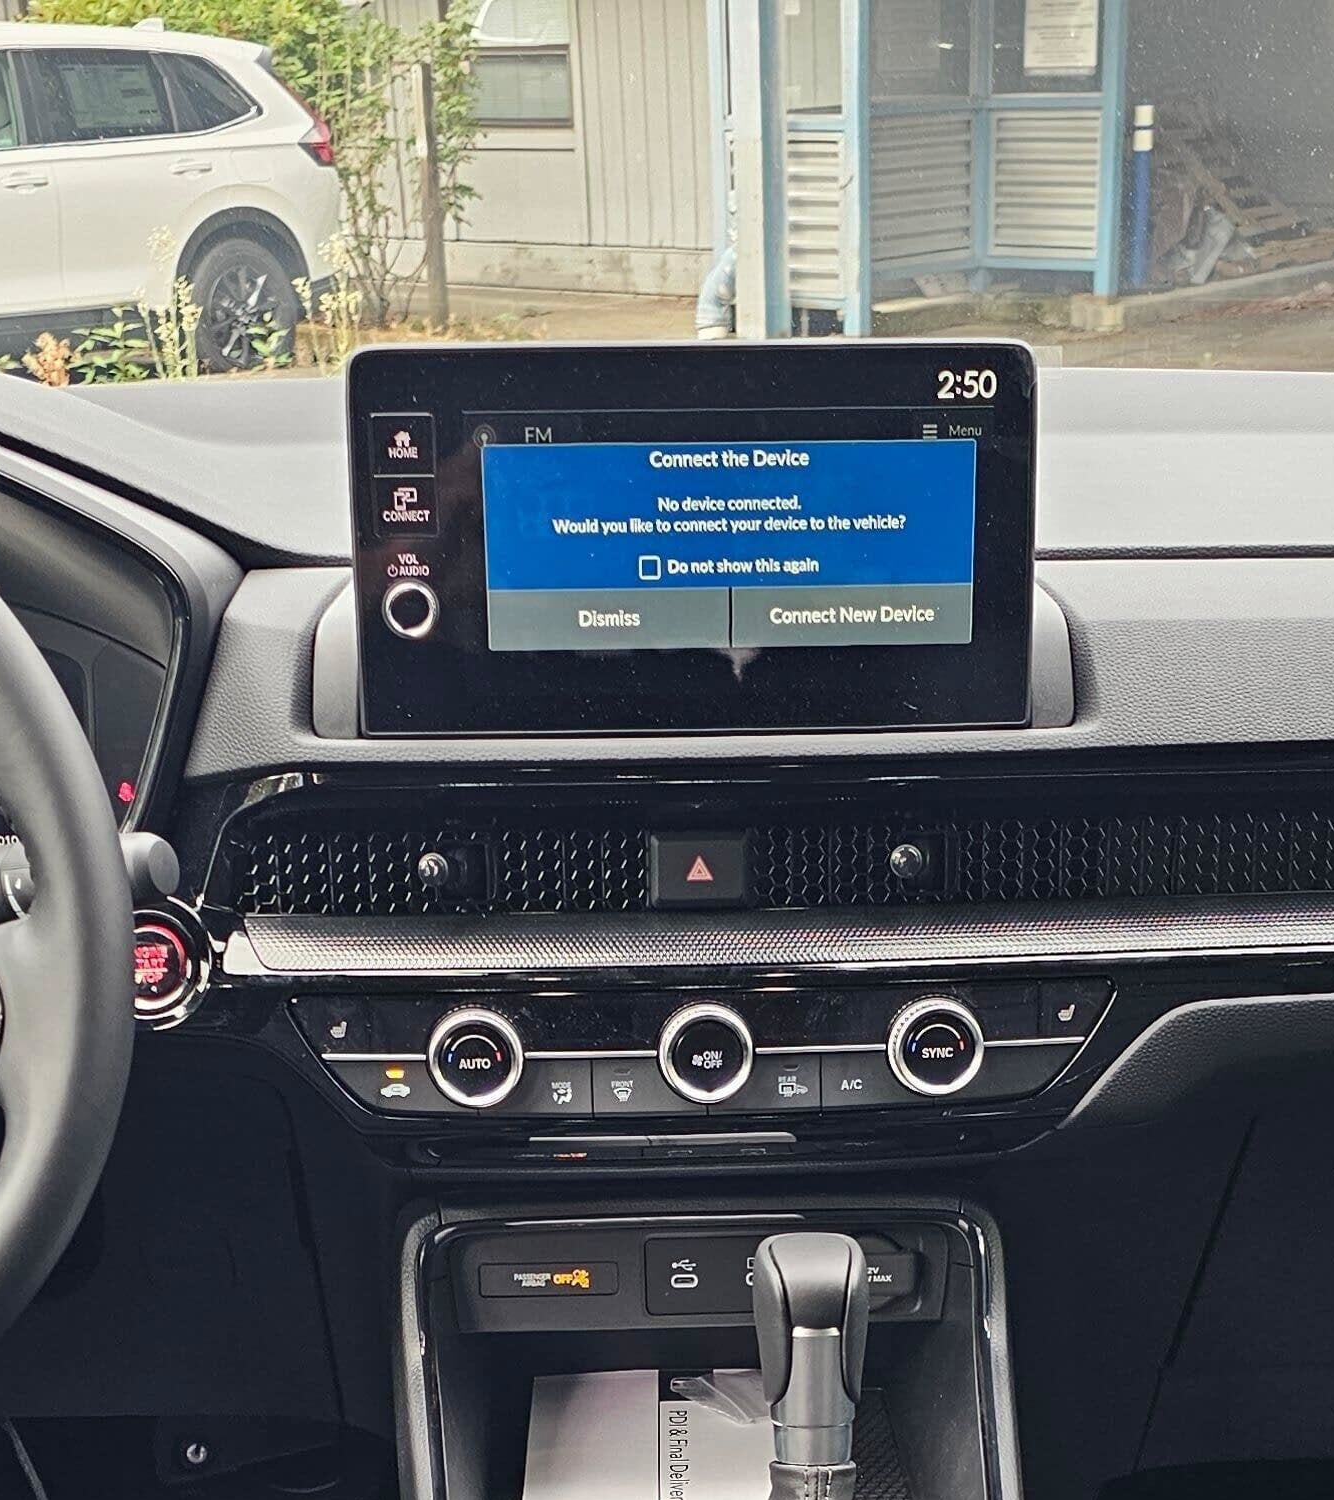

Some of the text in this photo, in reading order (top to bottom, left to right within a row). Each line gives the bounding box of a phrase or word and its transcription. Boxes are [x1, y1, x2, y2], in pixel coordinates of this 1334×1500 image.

[937, 370, 997, 400] 2:50
[524, 426, 552, 443] FM
[948, 423, 982, 438] Menu
[388, 447, 418, 458] HOME
[649, 449, 809, 468] Connect the Device
[658, 495, 801, 512] No device connected.
[382, 510, 430, 522] CONNECT
[552, 515, 906, 537] Would you like to connect your device to the vehicle?
[397, 554, 419, 565] VOL
[399, 566, 430, 577] AUDIO
[667, 557, 819, 575] Do not show this again
[578, 609, 641, 627] Dismiss
[770, 604, 934, 624] Connect New Device
[704, 1051, 722, 1062] ON/
[921, 1047, 954, 1059] SYNC
[458, 1058, 492, 1070] AUTO
[704, 1059, 723, 1069] OFF
[551, 1081, 572, 1089] MODE
[611, 1080, 634, 1089] FRONT
[840, 1079, 863, 1091] A/C
[553, 1274, 573, 1285] OFF
[669, 1410, 687, 1426] PDI
[669, 1439, 689, 1461] Final
